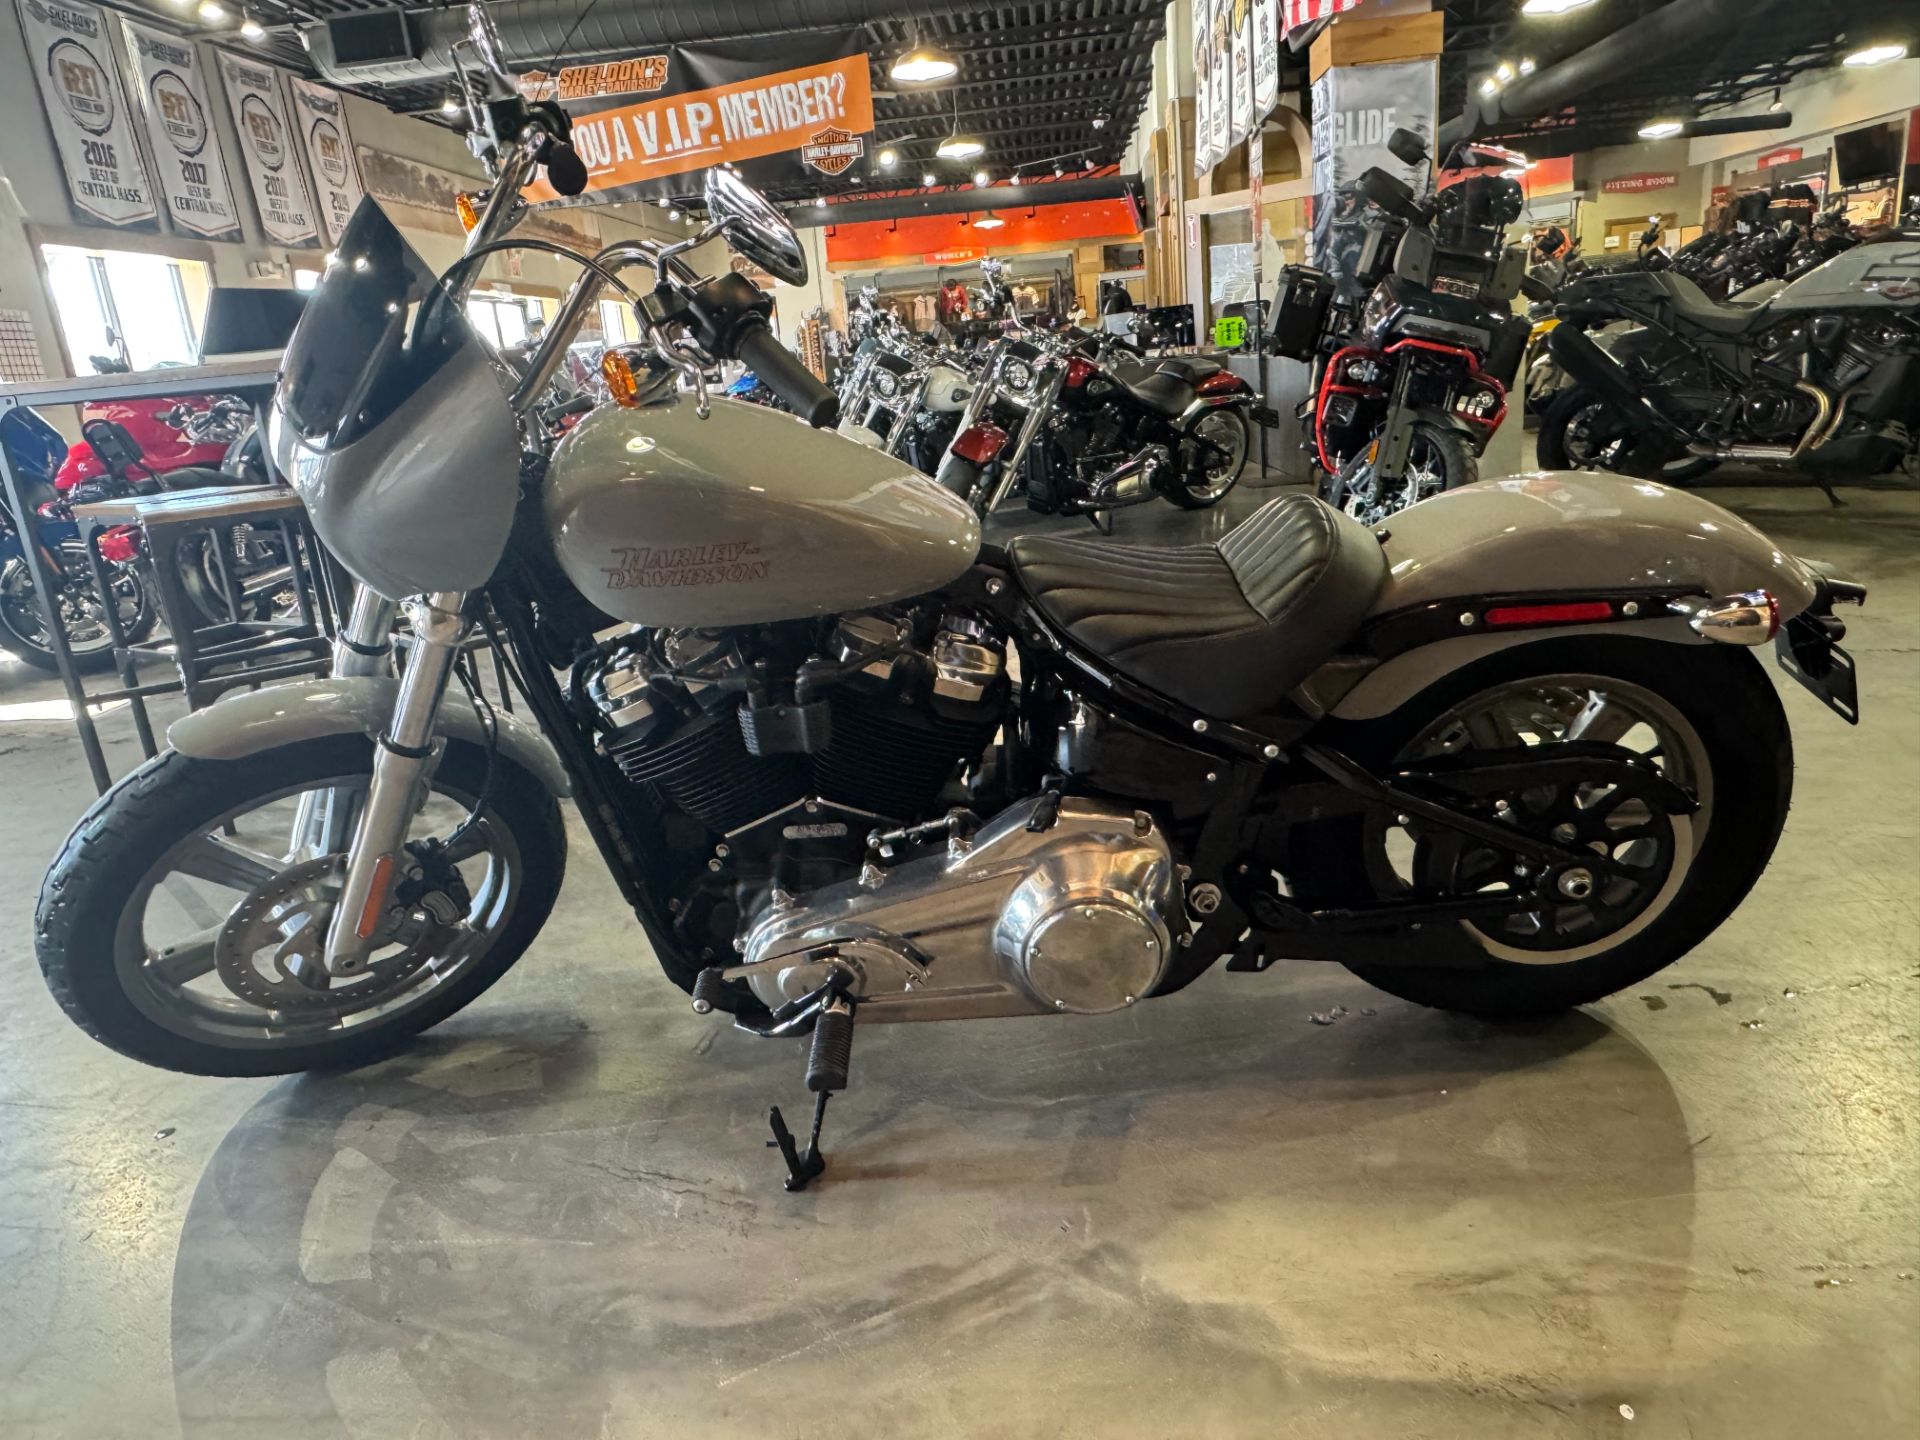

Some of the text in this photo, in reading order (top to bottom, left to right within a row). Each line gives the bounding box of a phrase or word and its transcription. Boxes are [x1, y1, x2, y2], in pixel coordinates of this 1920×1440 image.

[560, 57, 667, 88] SHELDON'S
[559, 77, 661, 99] HARLEY-DAVIDSON
[569, 72, 846, 169] OU A V.I.P. MEMBER?
[1332, 107, 1397, 149] GLIDE
[817, 132, 847, 144] MOTOR
[81, 139, 118, 169] 2016
[179, 159, 208, 185] 2017
[78, 180, 116, 200] CENTRAL
[935, 250, 973, 260] WOMEN'S
[601, 560, 770, 590] DAVIDSON
